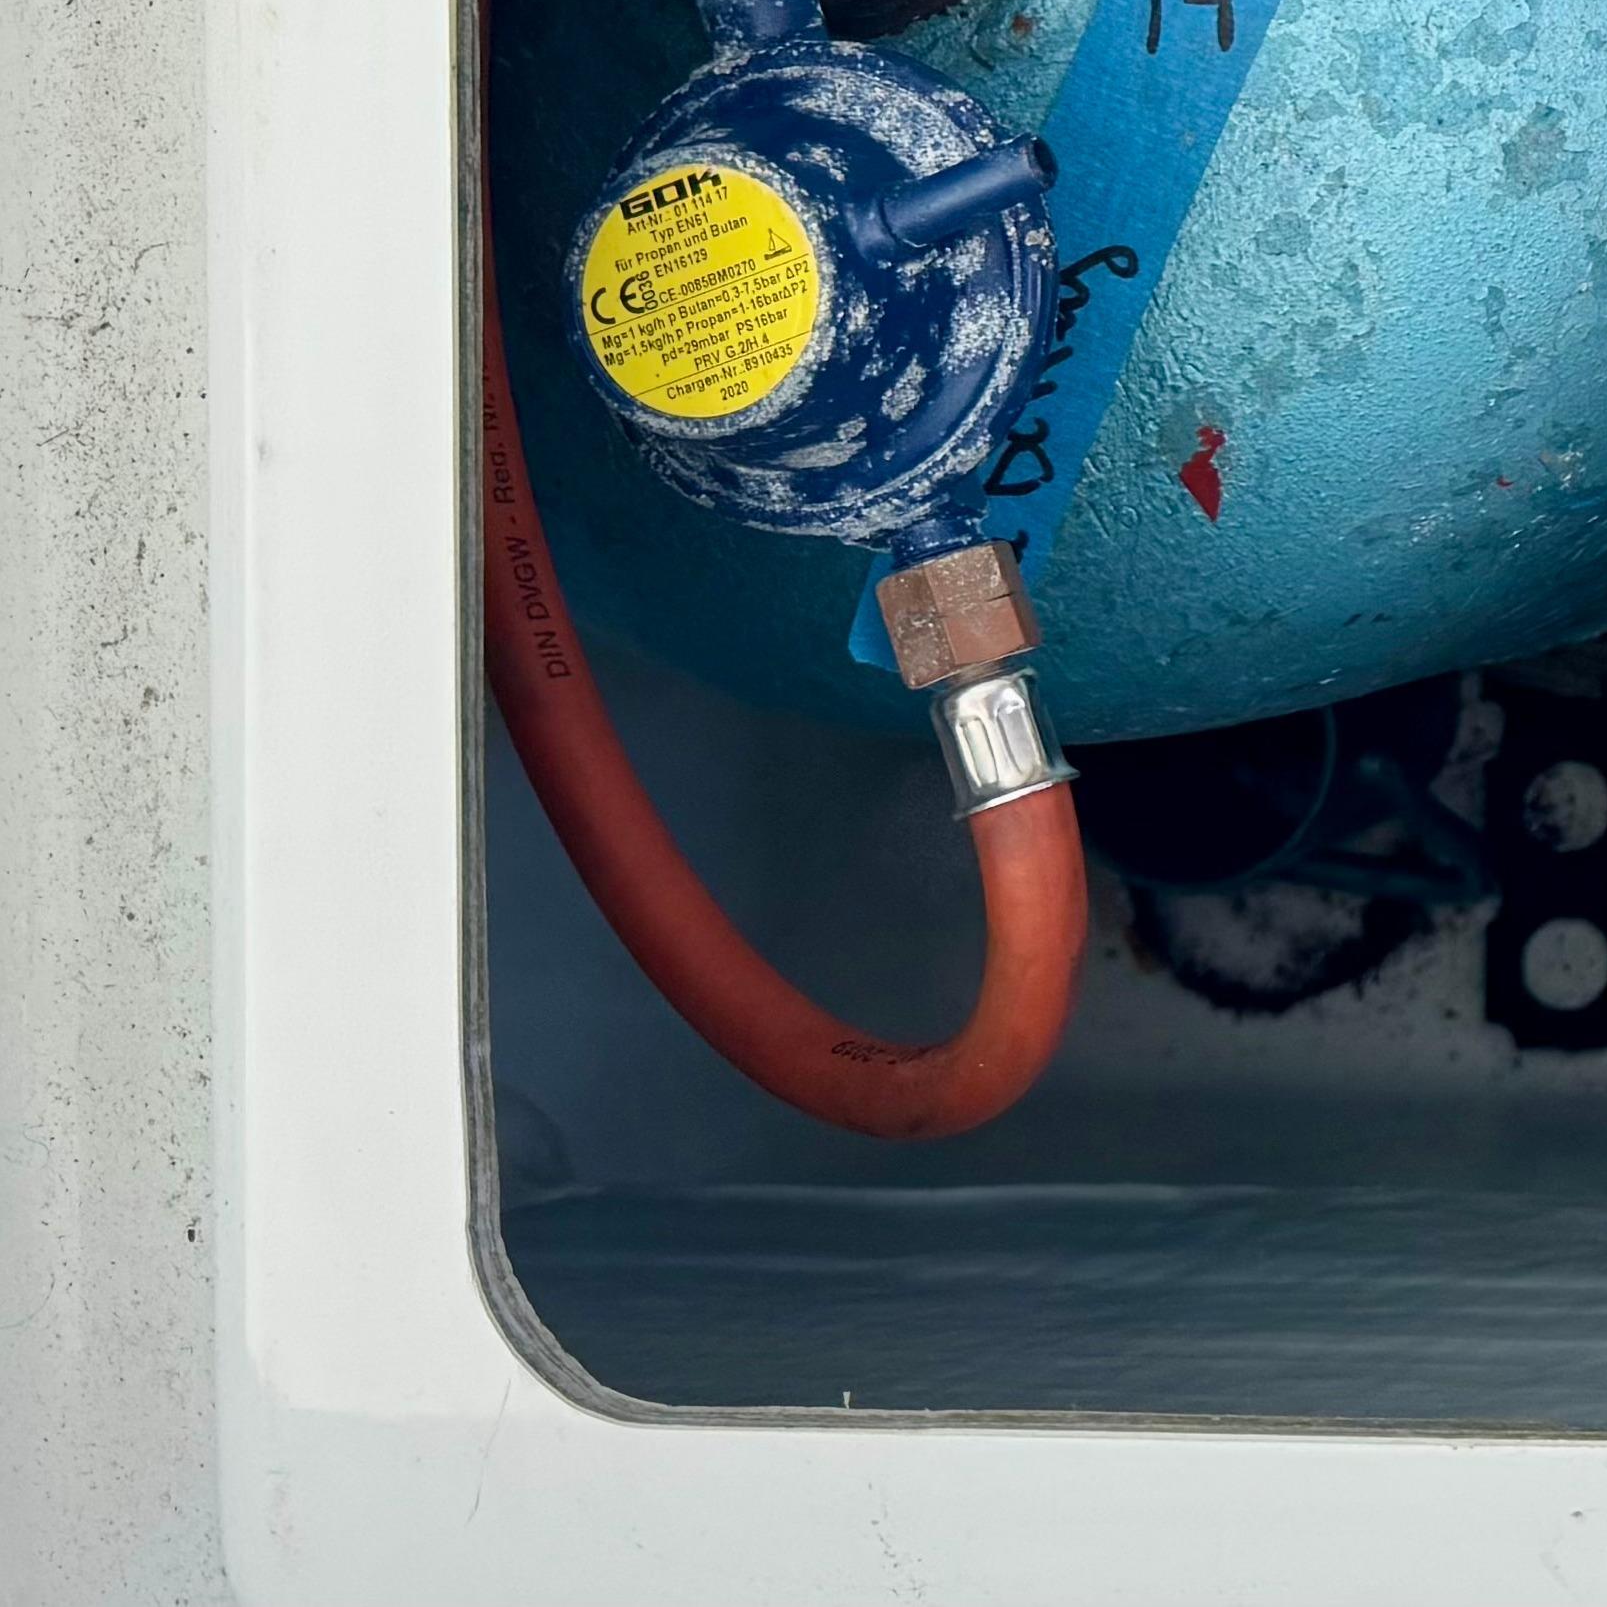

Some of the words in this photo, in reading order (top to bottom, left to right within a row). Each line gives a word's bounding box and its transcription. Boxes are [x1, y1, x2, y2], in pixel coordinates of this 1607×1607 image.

[619, 171, 723, 221] GOK
[673, 201, 689, 218] 01
[691, 193, 713, 213] 114
[714, 186, 729, 202] 17
[615, 254, 634, 274] für
[635, 241, 682, 269] Propan
[684, 229, 709, 251] und
[712, 216, 748, 239] Butan
[649, 226, 675, 245] Typ
[677, 211, 710, 235] EN61
[654, 250, 709, 278] EN16129
[694, 353, 722, 371] PRV
[719, 380, 749, 401] 2020
[505, 536, 551, 620] DVGW
[533, 630, 572, 680] DIN
